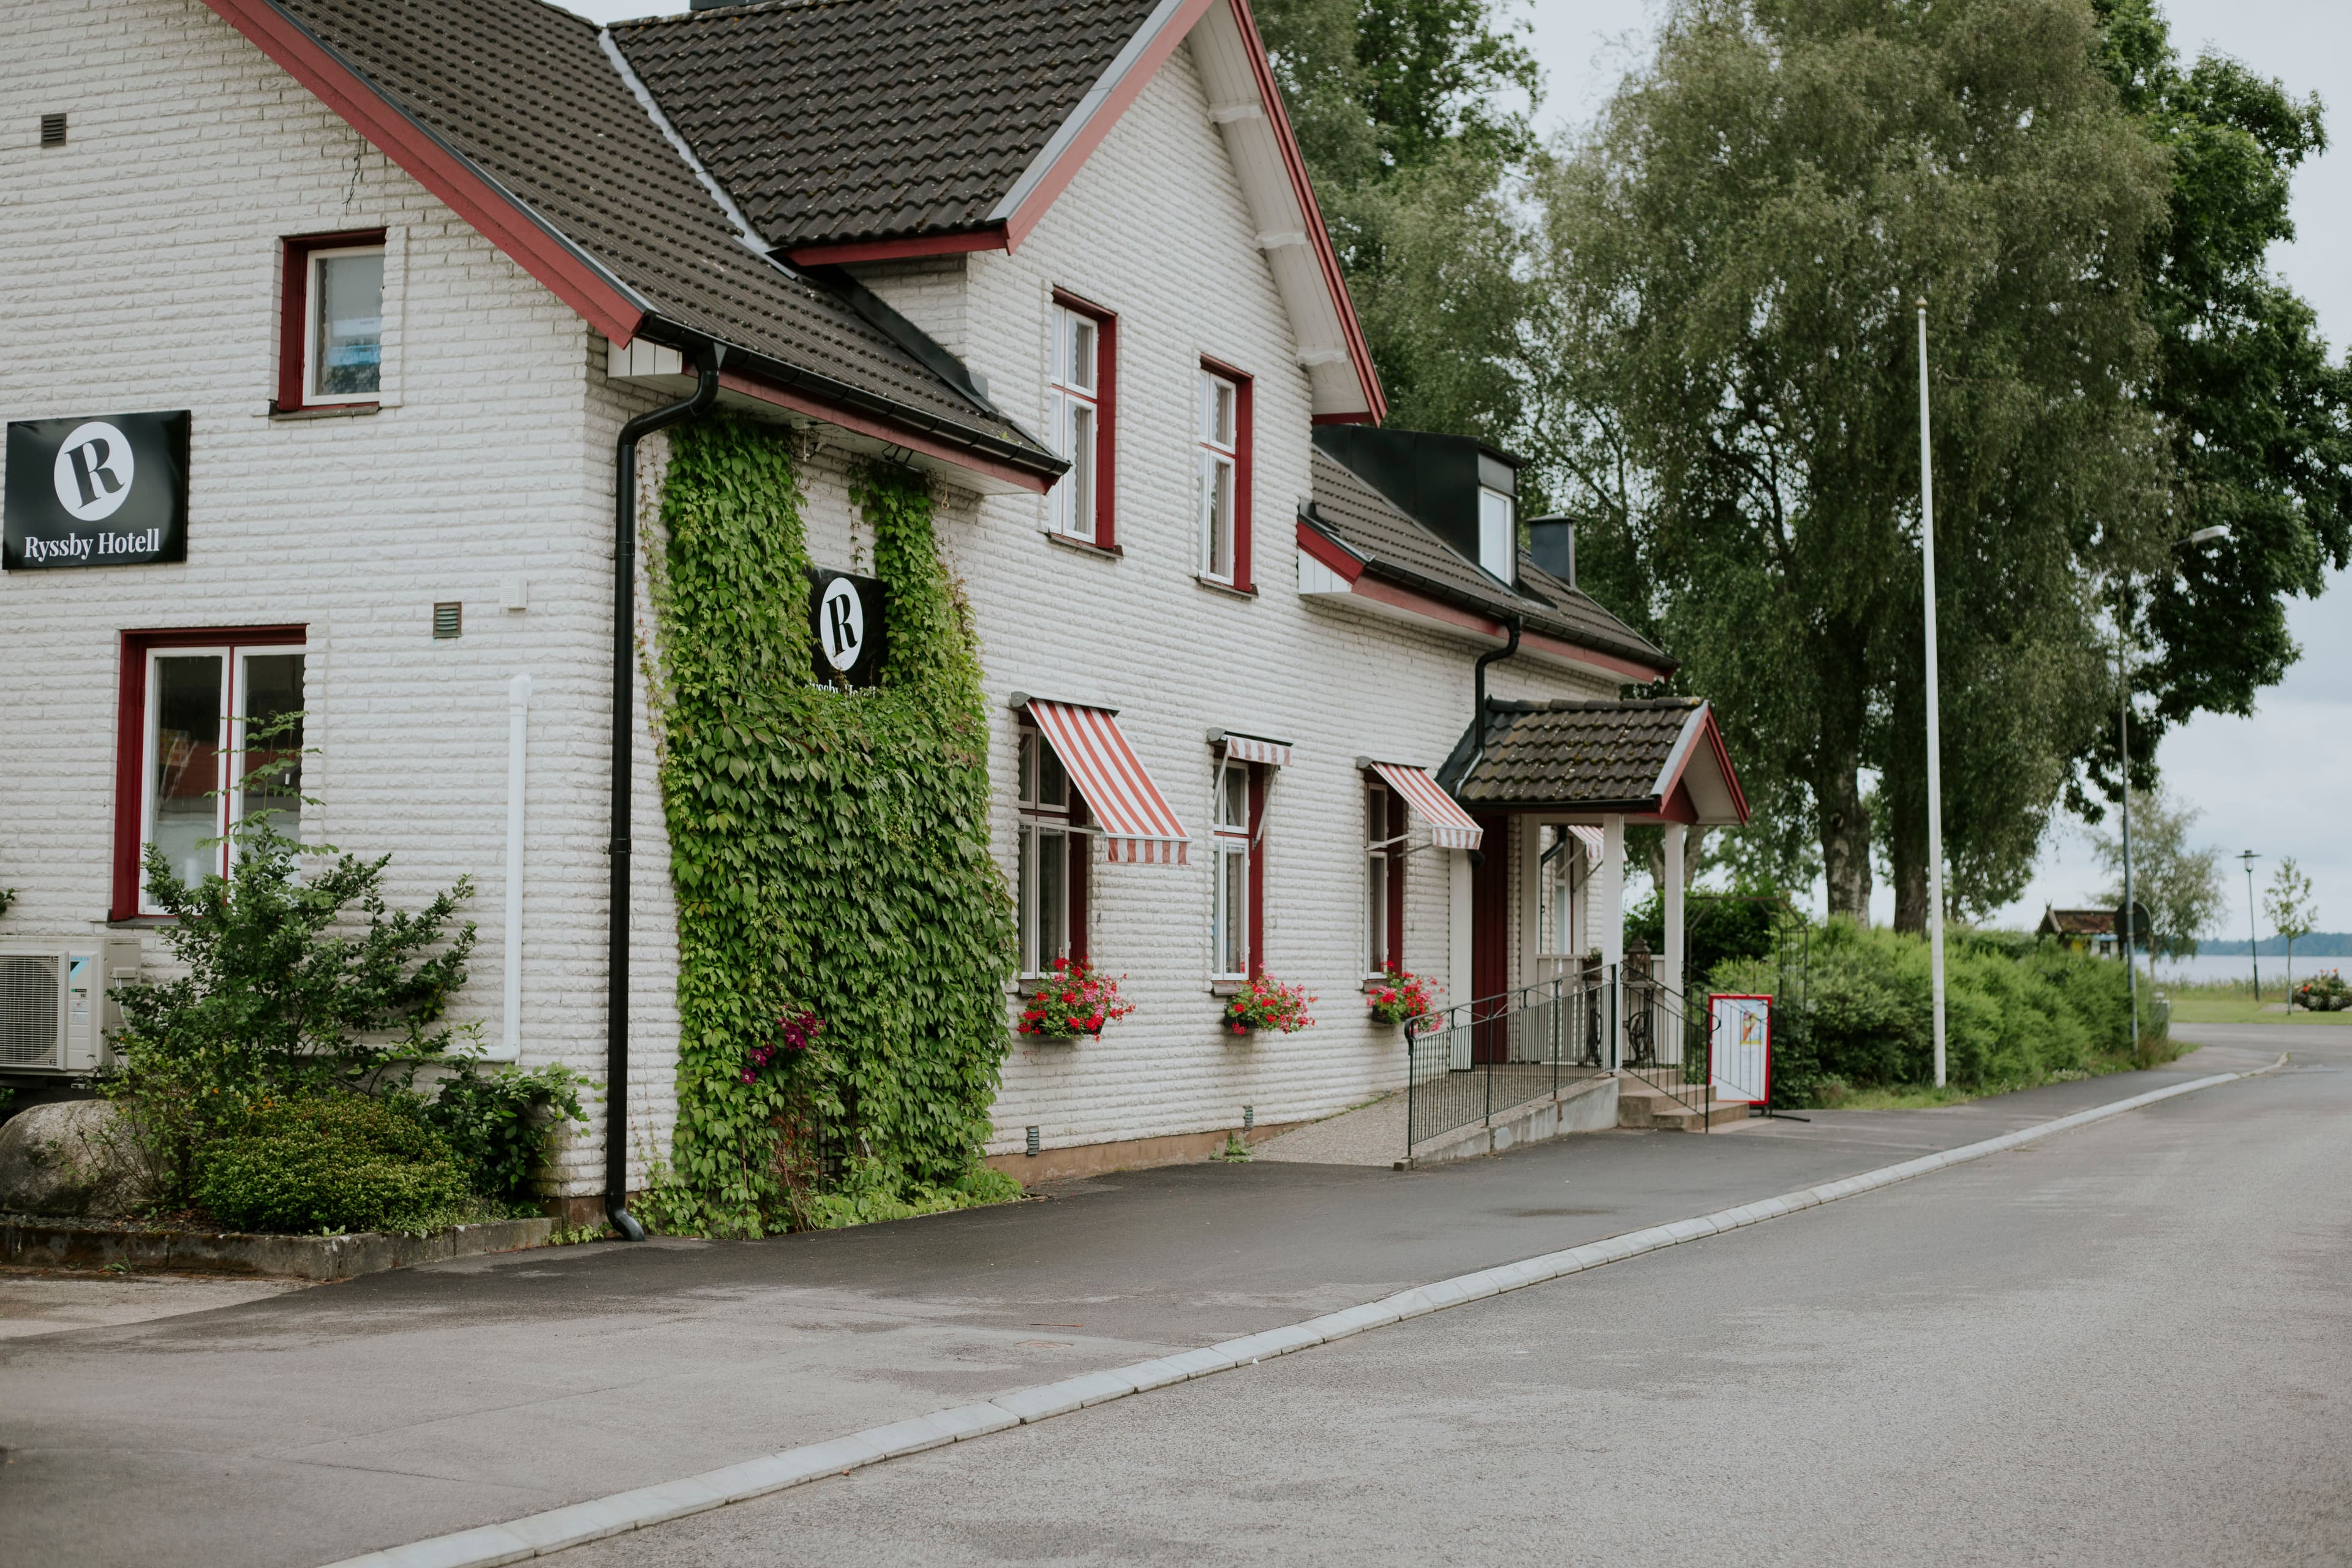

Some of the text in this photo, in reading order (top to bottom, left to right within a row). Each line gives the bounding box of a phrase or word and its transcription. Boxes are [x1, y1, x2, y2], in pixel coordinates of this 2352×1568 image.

[64, 438, 125, 509] R
[24, 528, 159, 562] Ryssby Hotell
[826, 594, 858, 657] R
